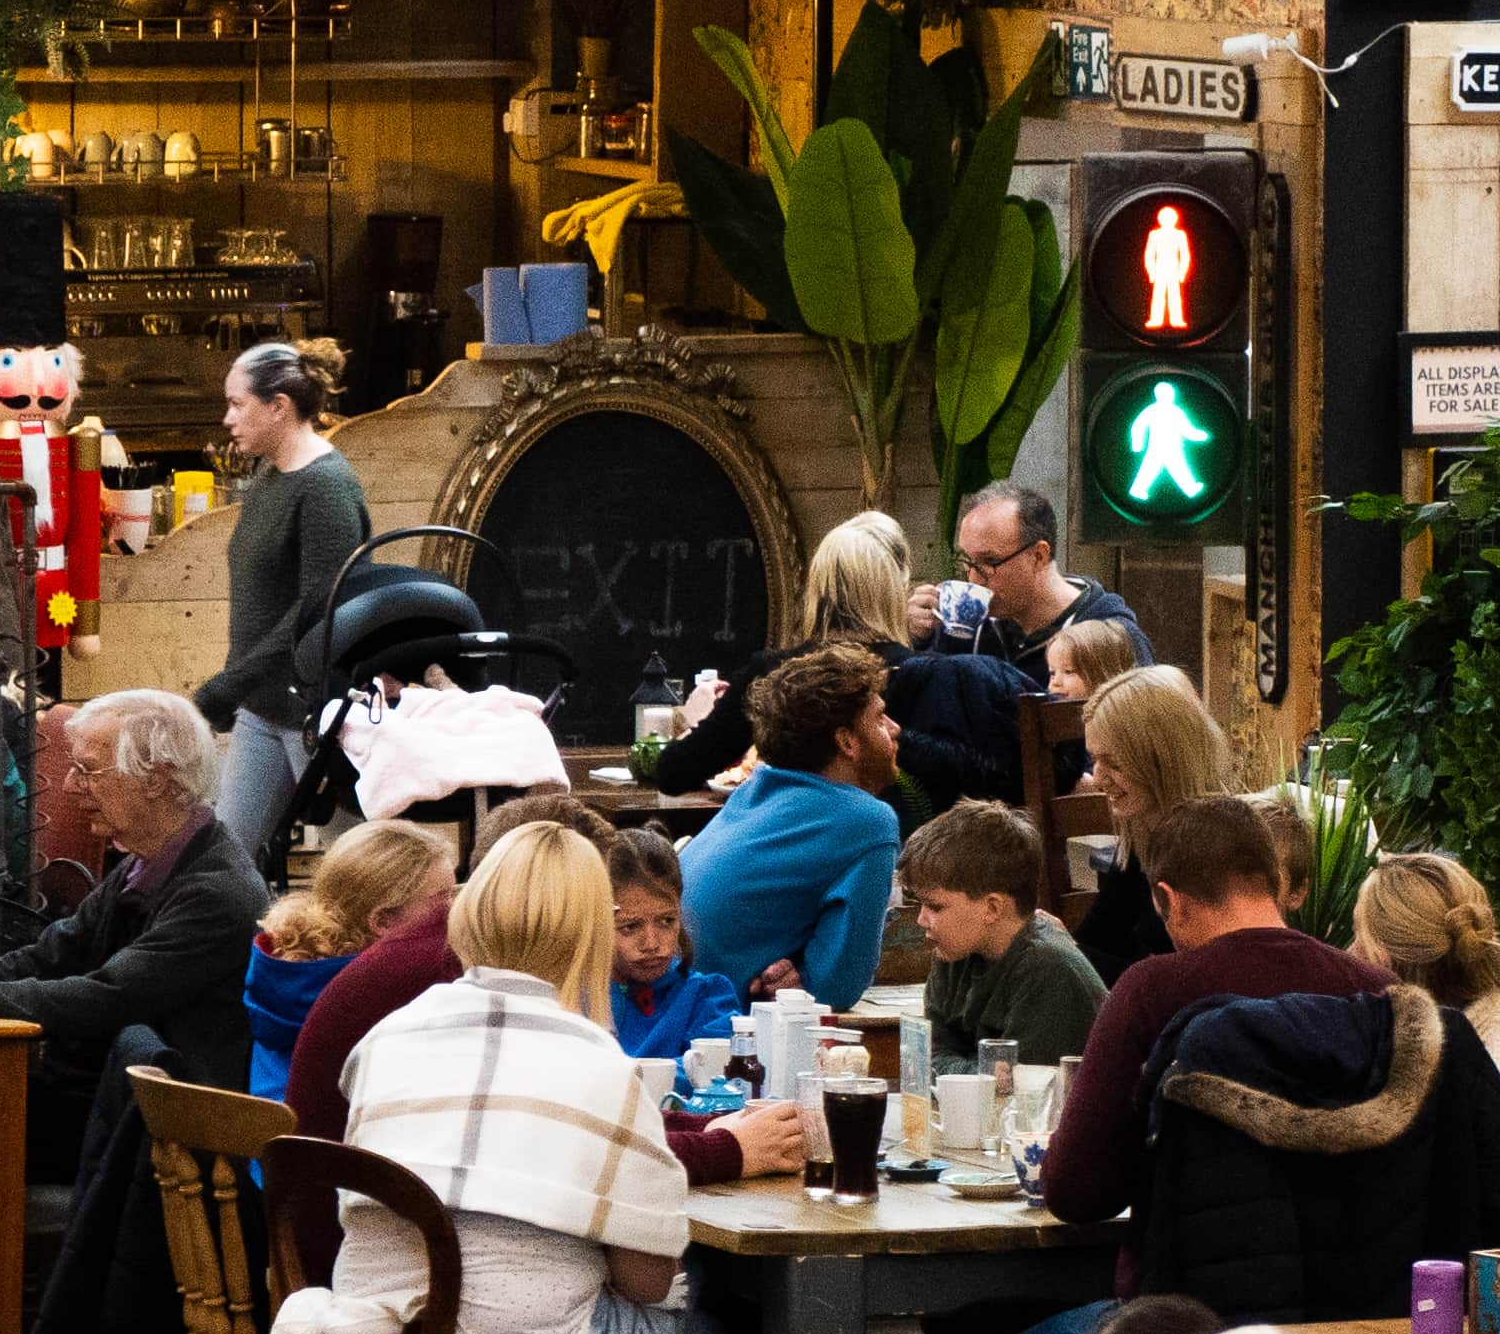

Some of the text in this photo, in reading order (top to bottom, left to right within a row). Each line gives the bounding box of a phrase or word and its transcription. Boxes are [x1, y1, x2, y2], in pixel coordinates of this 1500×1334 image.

[1121, 63, 1241, 112] LADIES
[1417, 367, 1444, 381] ALL
[1426, 383, 1469, 397] ITEMS
[1429, 398, 1499, 413] FOR SALE
[512, 538, 755, 643] EXIT
